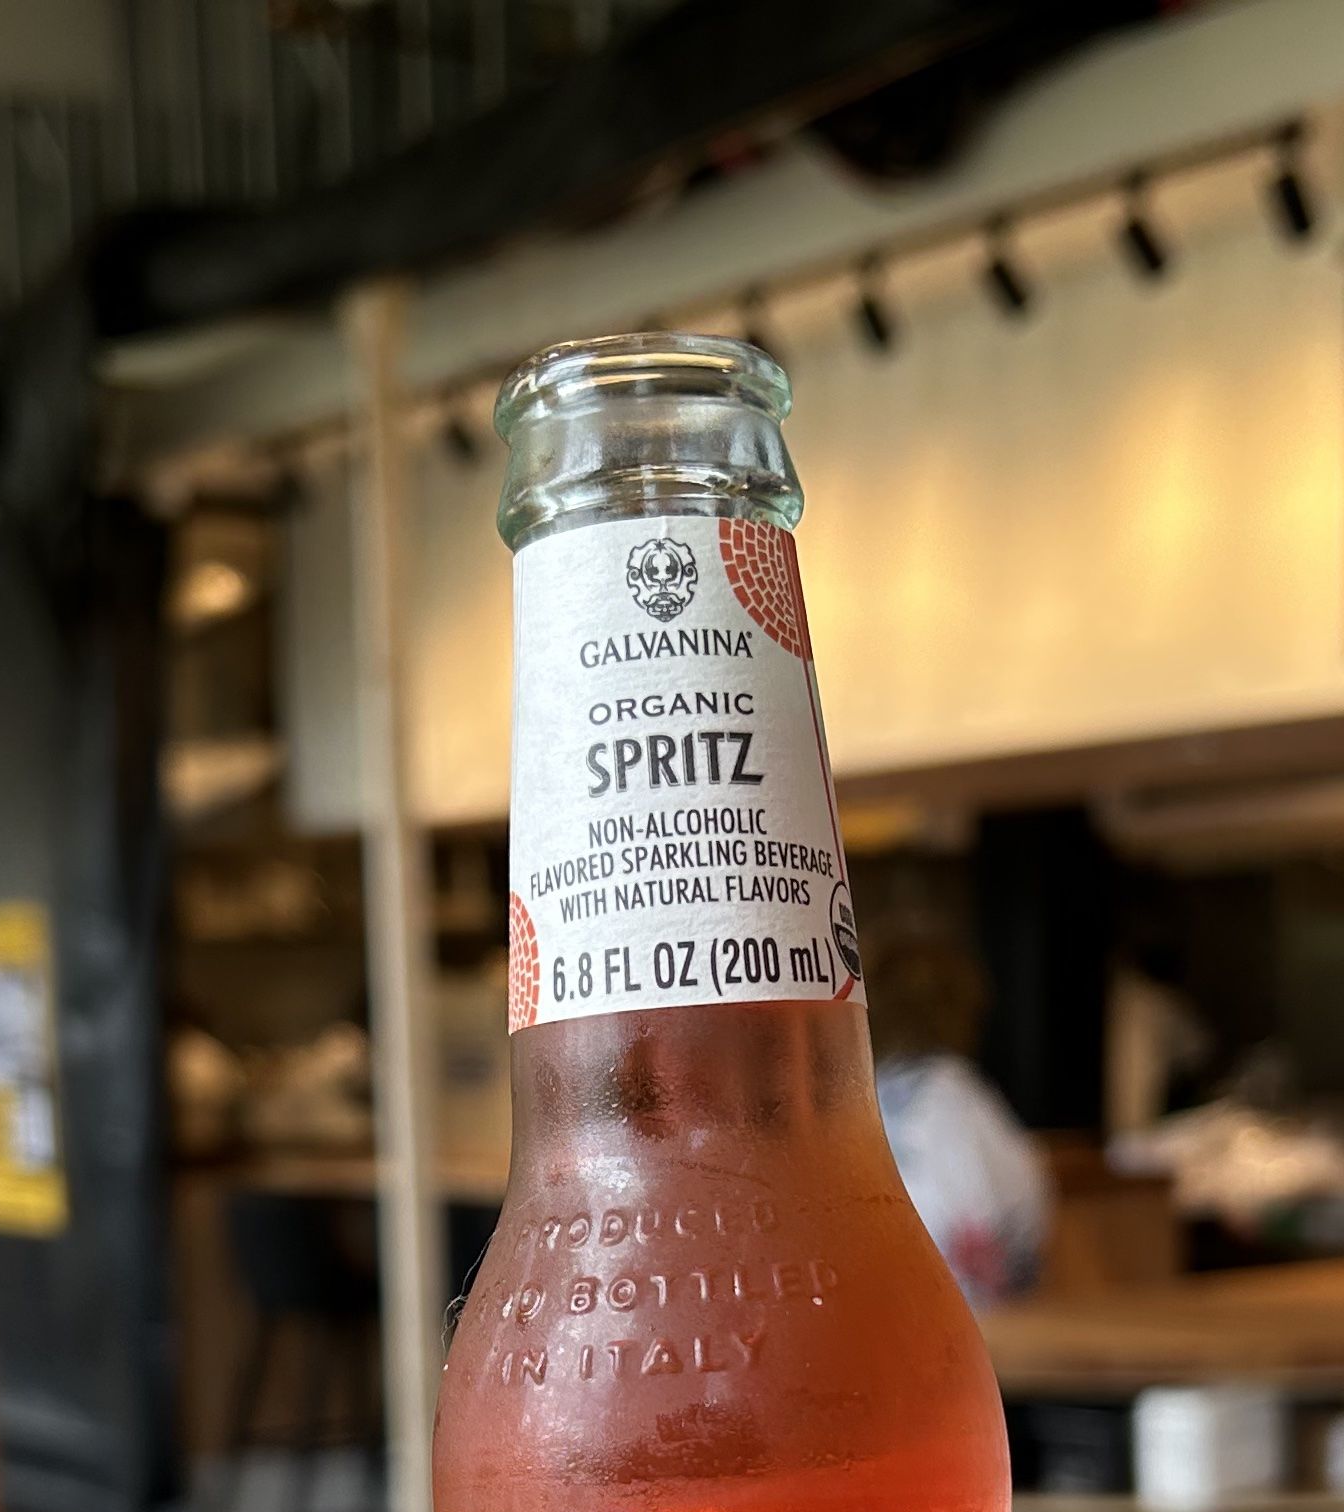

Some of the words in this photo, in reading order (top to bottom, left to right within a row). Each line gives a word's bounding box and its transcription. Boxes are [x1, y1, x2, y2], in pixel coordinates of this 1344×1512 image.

[589, 693, 755, 725] ORGANIC
[586, 732, 764, 797] SPRITZ
[588, 809, 767, 848] NON-ALCOHOLIC
[530, 852, 616, 902] FLAVORED
[622, 840, 747, 874] SPARKLING
[755, 840, 833, 879] BEVERAGE
[560, 890, 607, 924] WITH
[614, 877, 719, 911] NATURAL
[725, 873, 811, 906] FLAVORS
[553, 951, 594, 1002] 6.8
[605, 948, 641, 992] FL
[654, 941, 698, 989] OZ
[710, 937, 780, 996] (200
[790, 937, 836, 995] mL)
[569, 1258, 839, 1315] BOTTLED
[501, 1350, 548, 1386] IN
[578, 1322, 767, 1381] ITALY
